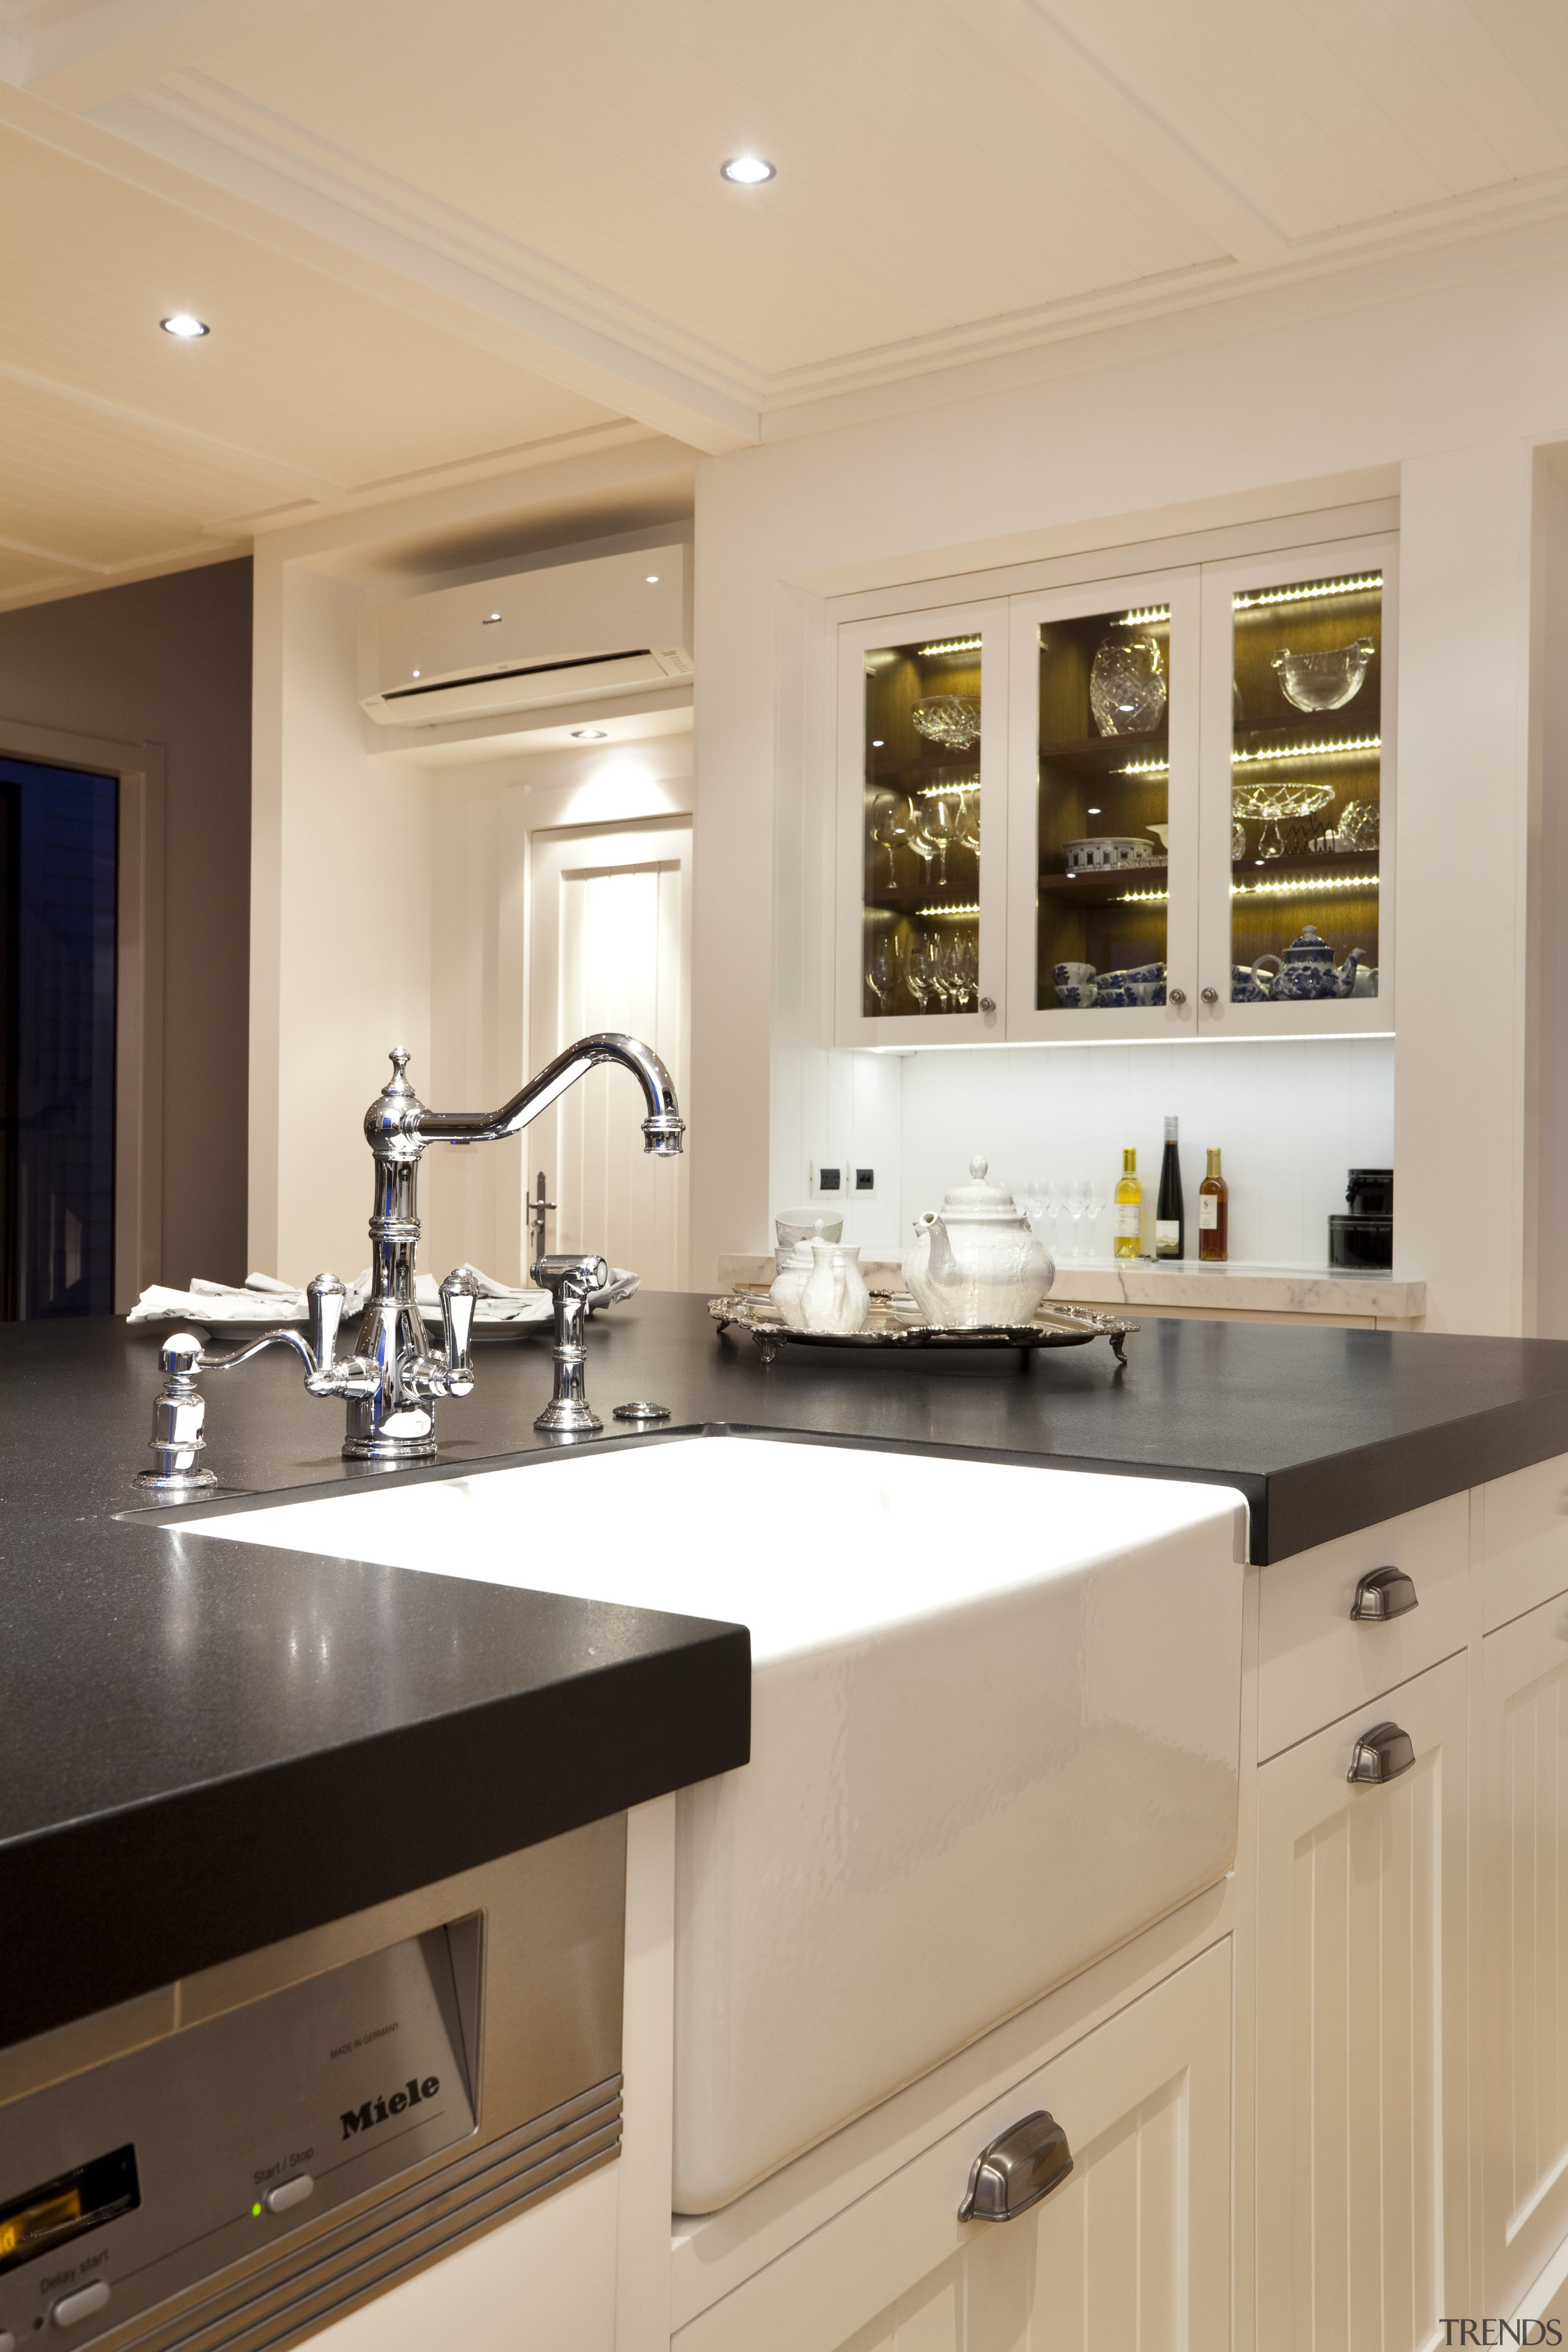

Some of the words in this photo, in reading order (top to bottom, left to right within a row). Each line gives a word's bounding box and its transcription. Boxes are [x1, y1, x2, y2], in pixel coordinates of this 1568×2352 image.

[330, 2042, 352, 2059] MADE
[354, 2038, 362, 2048] IN
[363, 2022, 399, 2045] GERMANY
[340, 2075, 440, 2141] Miele
[254, 2162, 281, 2185] Start
[288, 2147, 314, 2168] Stop
[40, 2267, 77, 2294] Delay
[79, 2248, 109, 2272] start
